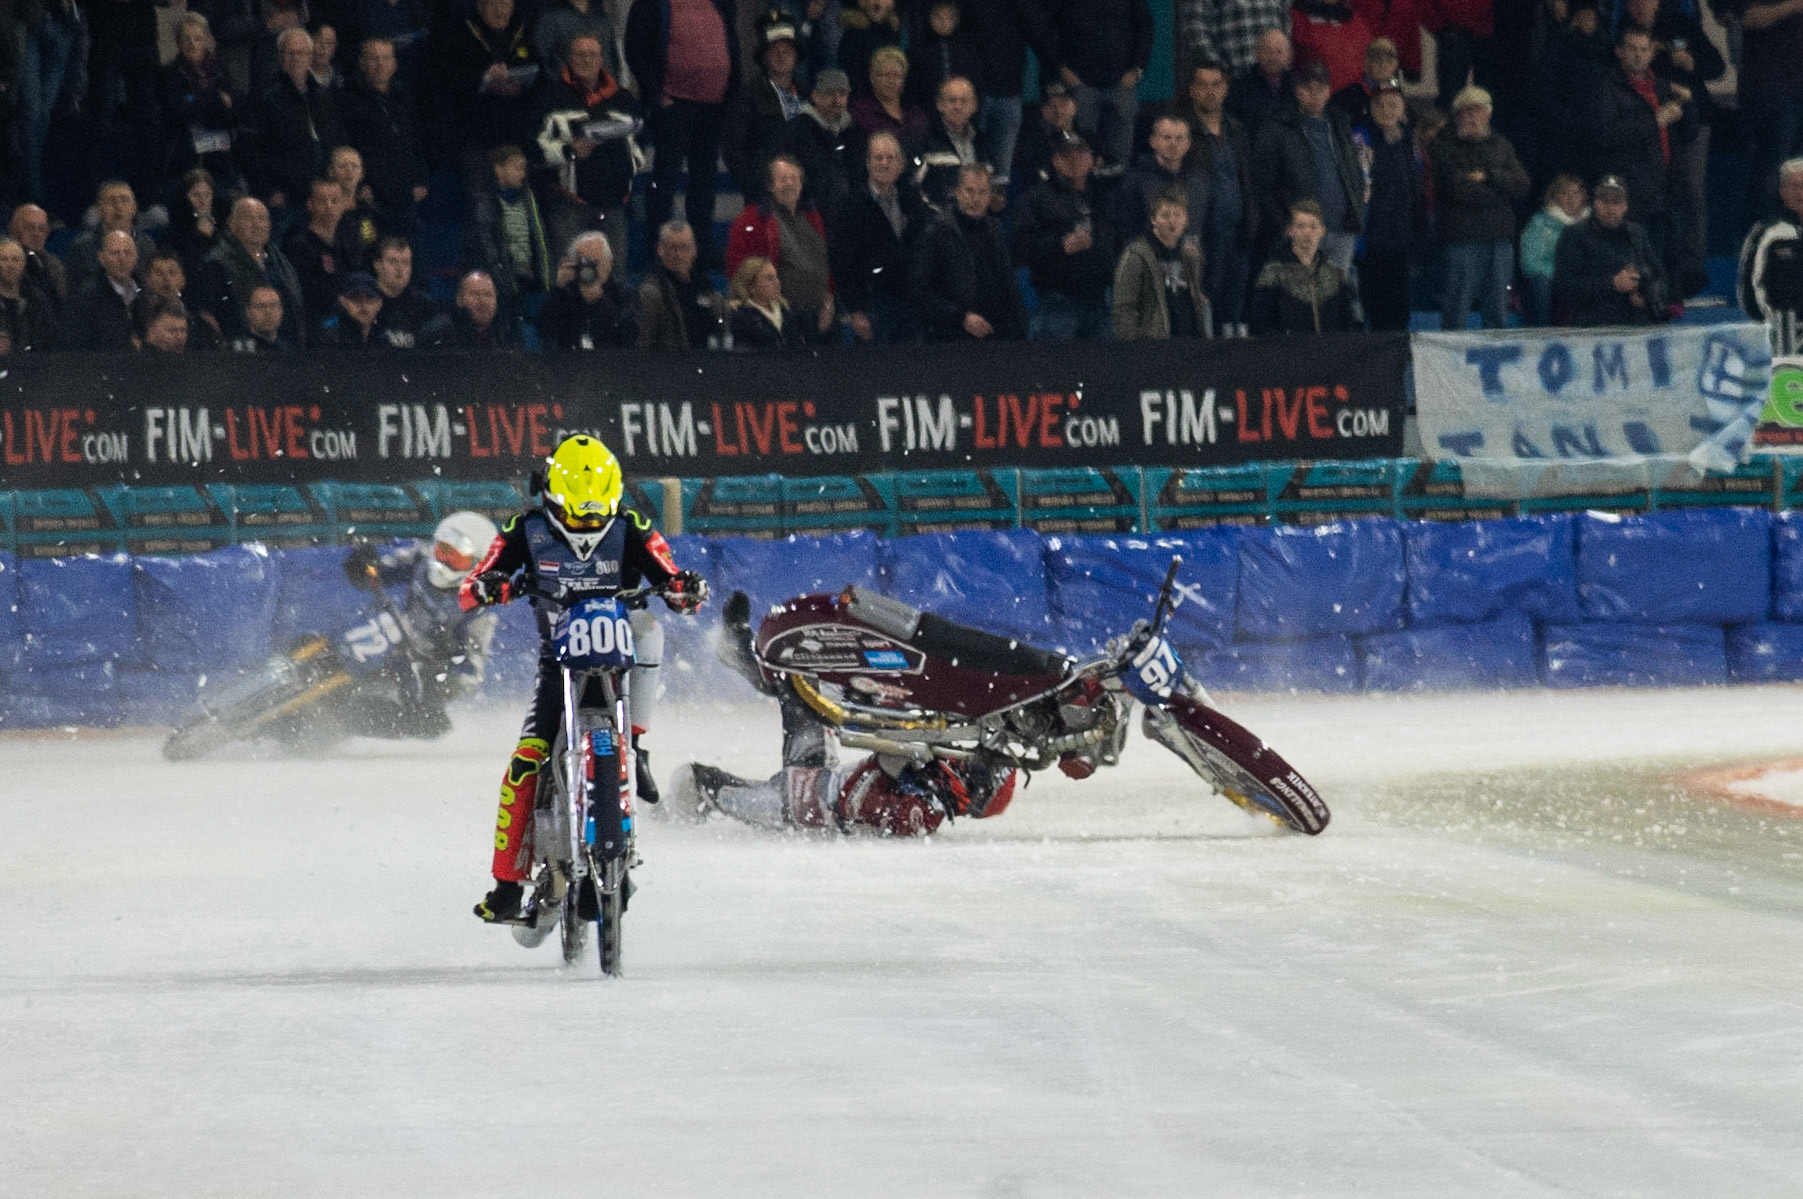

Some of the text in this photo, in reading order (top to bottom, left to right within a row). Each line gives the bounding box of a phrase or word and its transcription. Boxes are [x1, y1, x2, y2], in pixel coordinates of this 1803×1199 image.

[1465, 336, 1673, 399] TOMI
[568, 615, 634, 657] 800
[1139, 639, 1178, 692] 97
